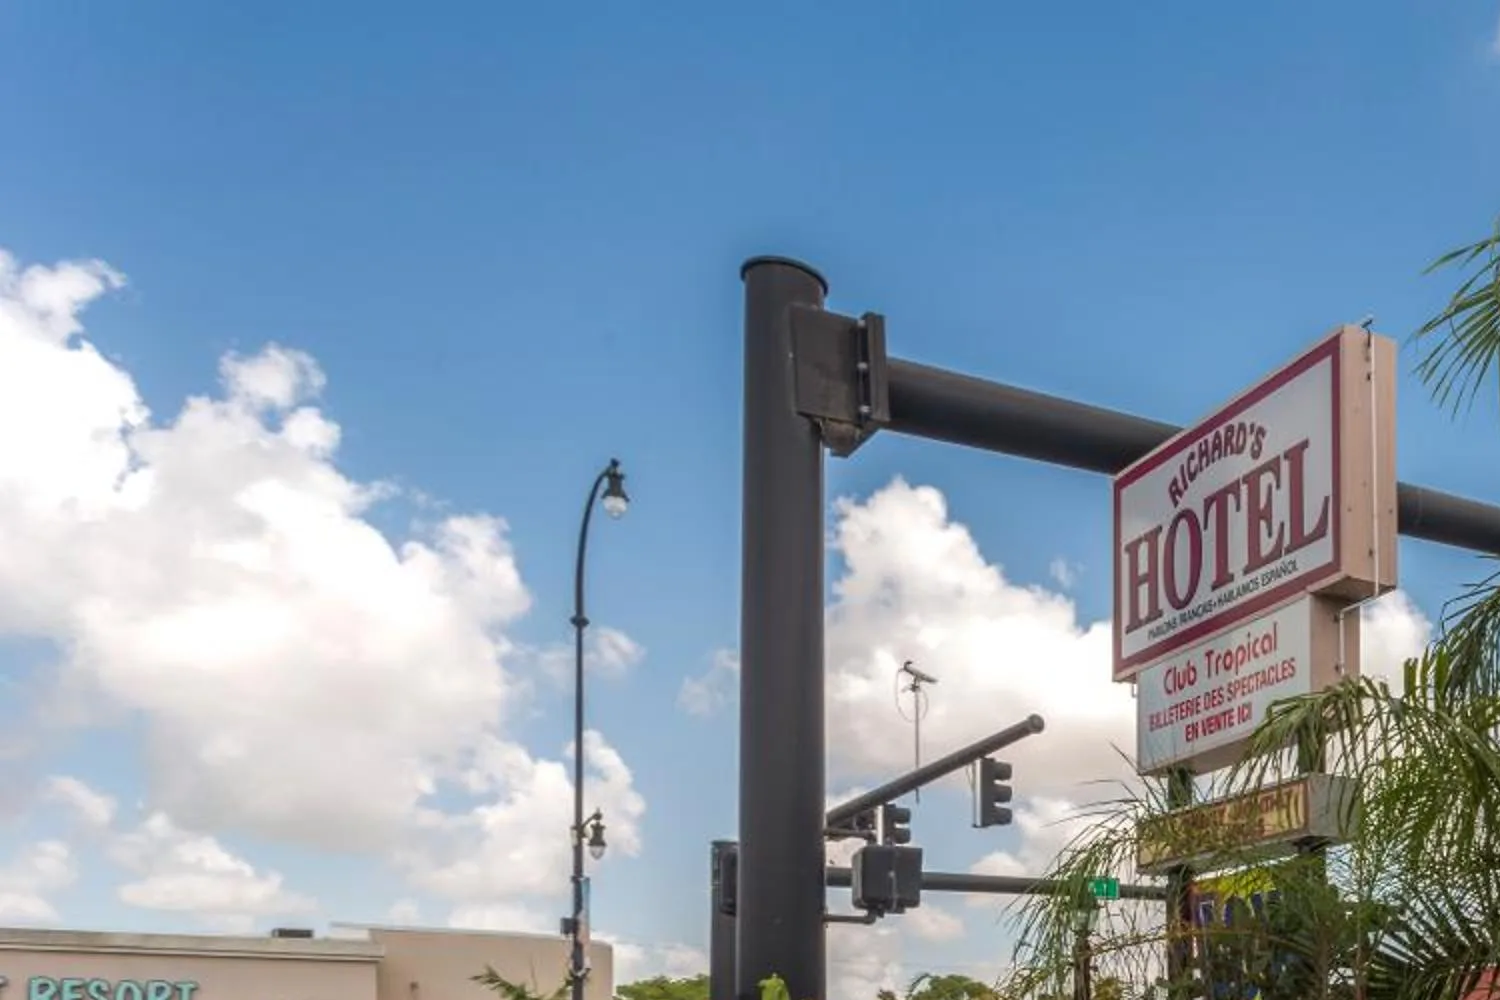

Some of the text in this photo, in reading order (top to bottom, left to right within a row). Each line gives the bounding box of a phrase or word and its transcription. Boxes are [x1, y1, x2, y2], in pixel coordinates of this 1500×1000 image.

[1168, 422, 1266, 508] RICHARD'S
[1124, 439, 1330, 634] HOTEL
[1149, 657, 1296, 732] BILLETERIE DES SPECTACLES
[1163, 621, 1278, 695] Club Tropical
[1185, 702, 1253, 742] EN VENTE ICI
